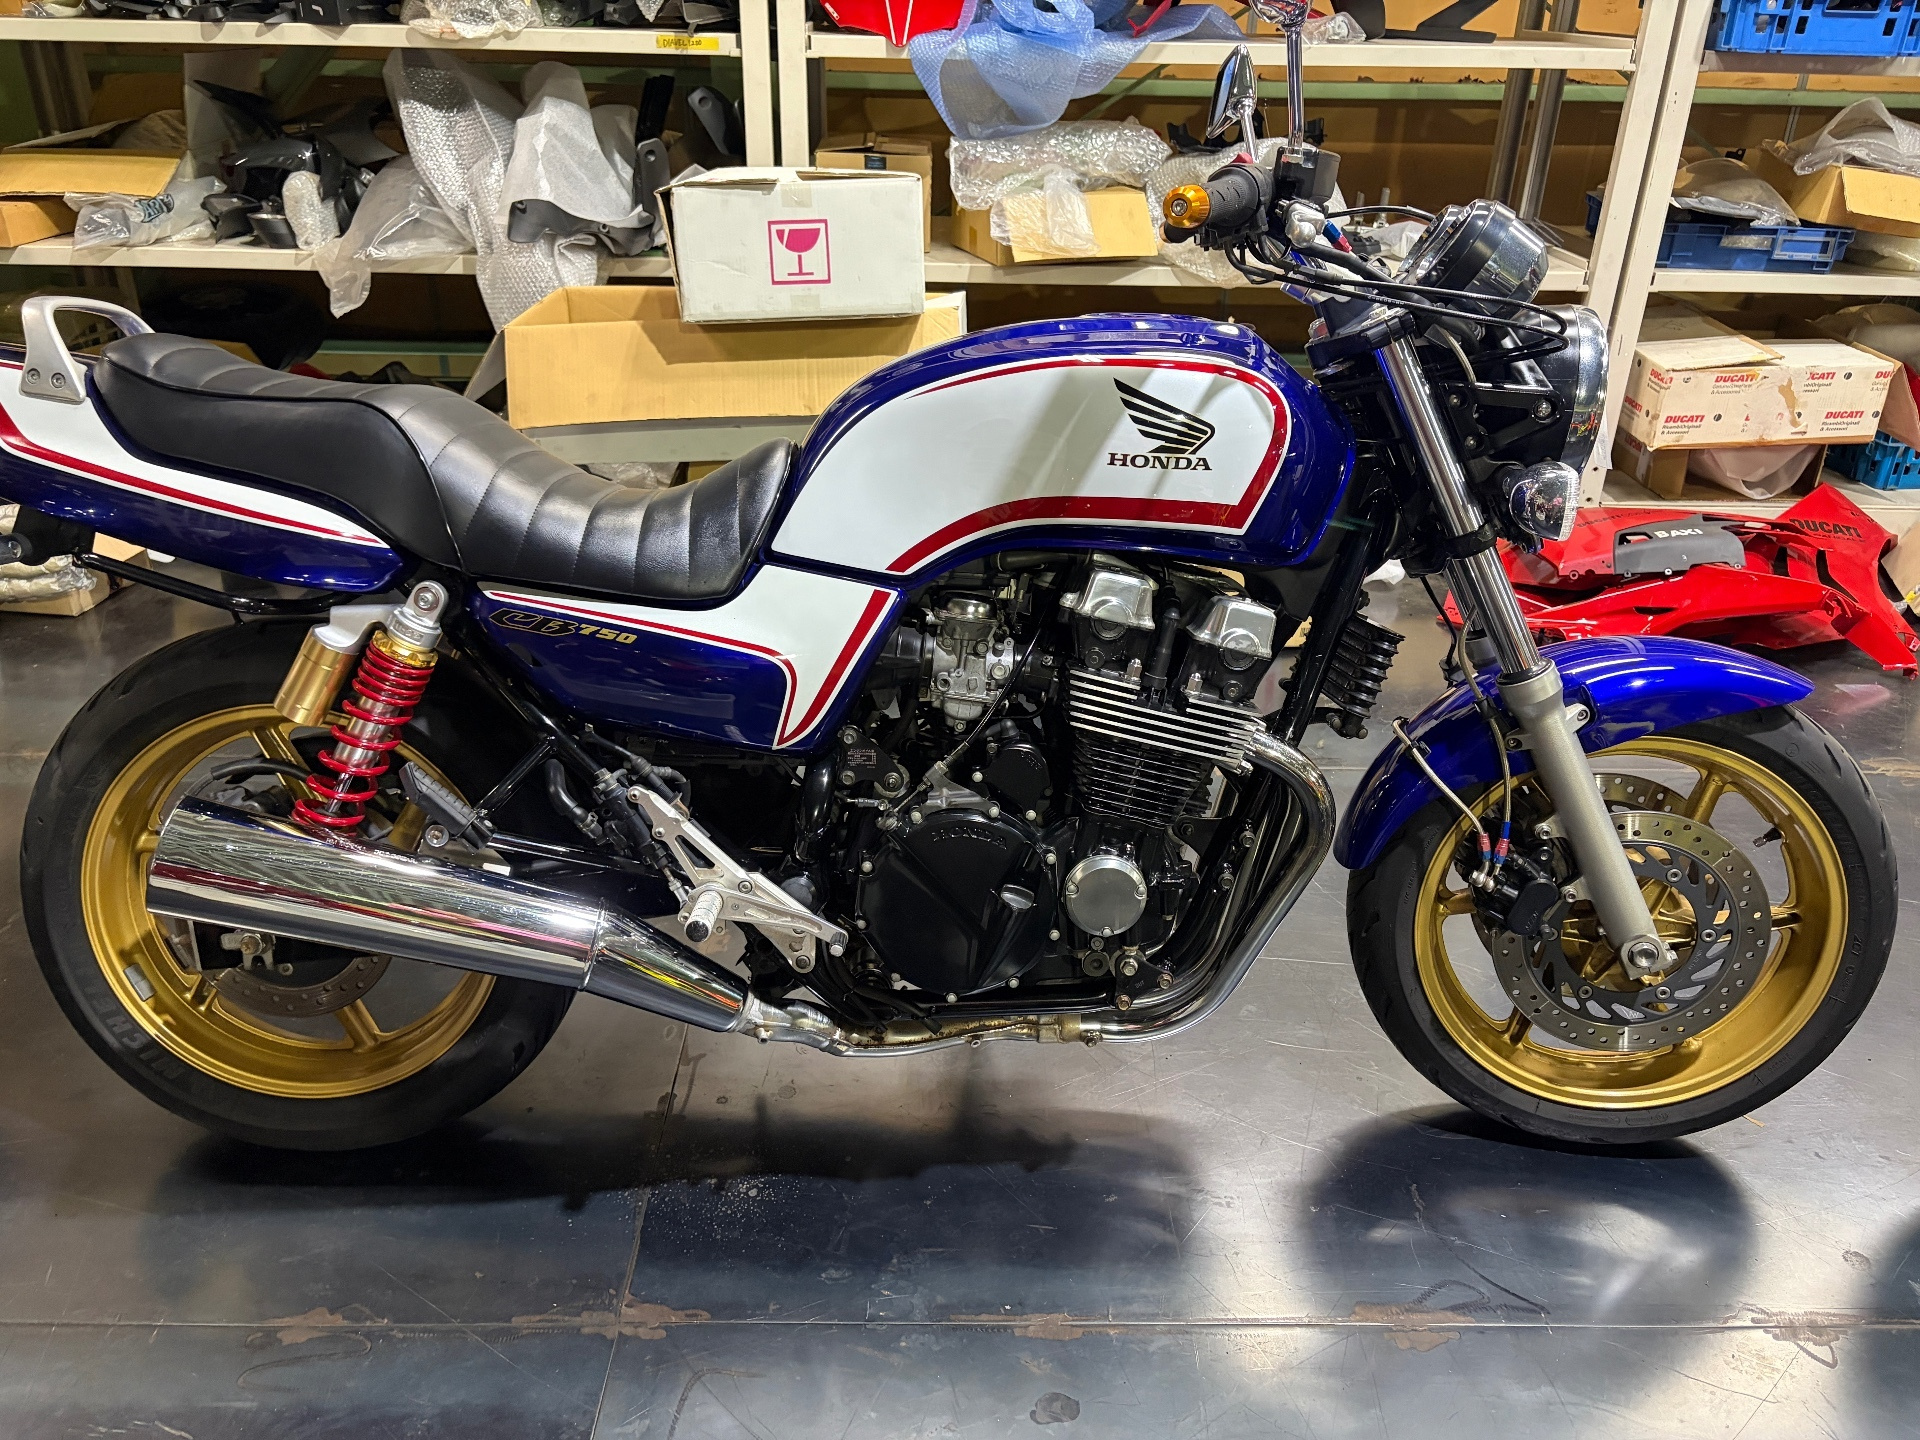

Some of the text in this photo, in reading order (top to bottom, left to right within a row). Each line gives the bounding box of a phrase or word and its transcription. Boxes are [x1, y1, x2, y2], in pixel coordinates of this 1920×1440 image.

[662, 39, 688, 47] DIAVEL
[1714, 374, 1756, 383] DUCATI
[1624, 395, 1643, 412] DUCATI
[1664, 415, 1706, 424] DUCATI
[1824, 410, 1865, 420] DUCATI
[1107, 452, 1213, 471] HONDA
[1789, 518, 1862, 539] DUCATI
[931, 826, 1008, 851] HONDA
